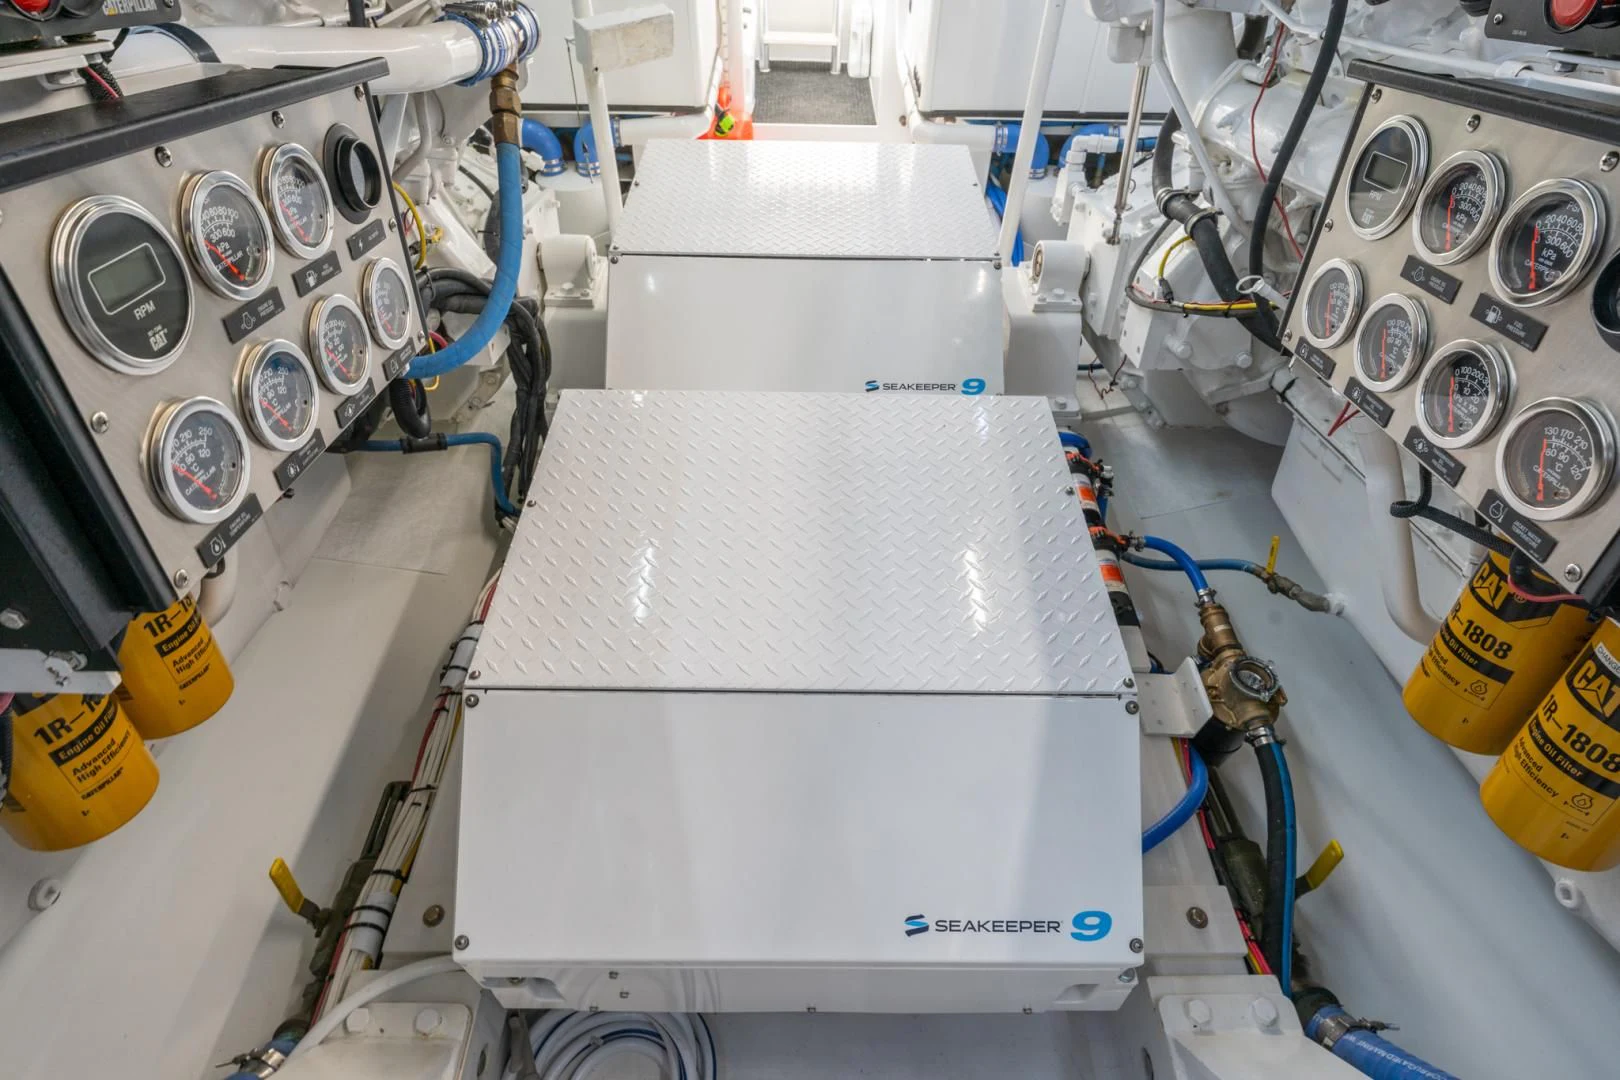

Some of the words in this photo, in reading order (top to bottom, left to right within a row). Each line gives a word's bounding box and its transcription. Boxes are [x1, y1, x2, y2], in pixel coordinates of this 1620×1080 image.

[227, 207, 239, 219] 100
[1545, 215, 1556, 224] 20
[1556, 215, 1567, 224] 40
[1566, 217, 1577, 228] 60
[1541, 248, 1557, 260] kPa
[1545, 235, 1560, 246] 300
[1560, 240, 1573, 258] 600
[215, 250, 244, 272] CATEPILLAR
[134, 300, 156, 321] RPM
[149, 330, 168, 352] CAT
[1460, 366, 1472, 375] 100
[1471, 368, 1484, 380] 200
[882, 382, 957, 391] SEAKEEPER
[960, 377, 987, 396] 9
[179, 429, 193, 443] 210
[198, 426, 213, 437] 250
[1544, 426, 1559, 435] 130
[1560, 428, 1574, 440] 170
[1574, 435, 1588, 450] 210
[199, 448, 211, 458] 120
[1545, 448, 1556, 457] 60
[1558, 451, 1569, 463] 90
[1570, 464, 1582, 481] 120
[185, 465, 217, 497] CATEPILLAR
[1512, 525, 1539, 549] TEMPERATURE
[1513, 519, 1528, 534] JACKET
[1527, 530, 1542, 544] WATER
[1472, 561, 1509, 611] CAT
[161, 631, 188, 653] Engine
[175, 657, 195, 675] High
[1458, 646, 1479, 666] Filter
[1573, 658, 1620, 719] CAT
[58, 733, 94, 761] Engine
[95, 721, 106, 736] Oil
[1542, 693, 1620, 774] 1R-1808
[72, 738, 117, 777] Advanced
[1544, 743, 1556, 759] Oil
[1556, 755, 1584, 778] Filter
[77, 764, 103, 783] High
[1520, 758, 1559, 799] Efficiency
[935, 919, 1062, 934] SEAKEEPER
[1070, 910, 1113, 942] 9
